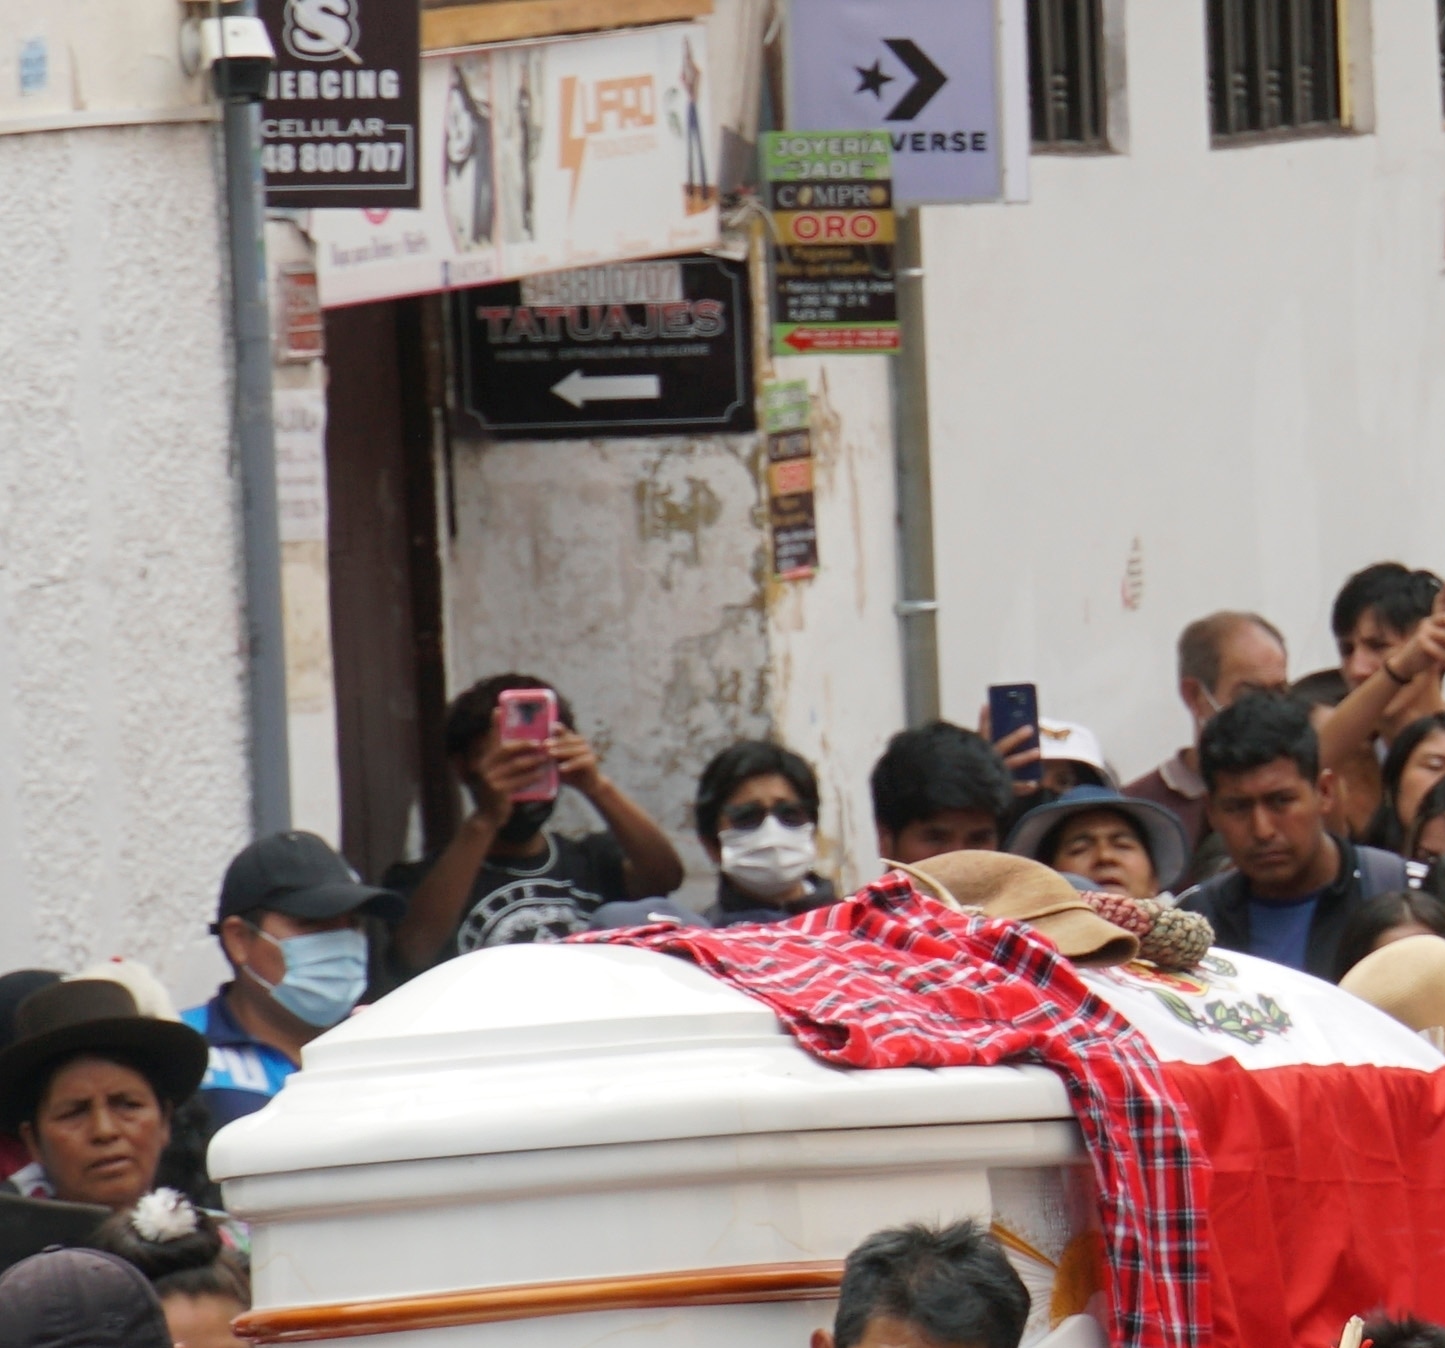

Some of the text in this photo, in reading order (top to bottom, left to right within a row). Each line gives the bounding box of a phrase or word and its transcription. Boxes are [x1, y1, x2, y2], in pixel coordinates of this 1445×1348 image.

[266, 69, 399, 99] IERCING
[261, 118, 384, 138] CELULAR
[890, 131, 988, 152] VERSE
[262, 141, 404, 174] 48 800 707
[793, 213, 878, 240] ORO
[476, 299, 726, 344] TATUAJES
